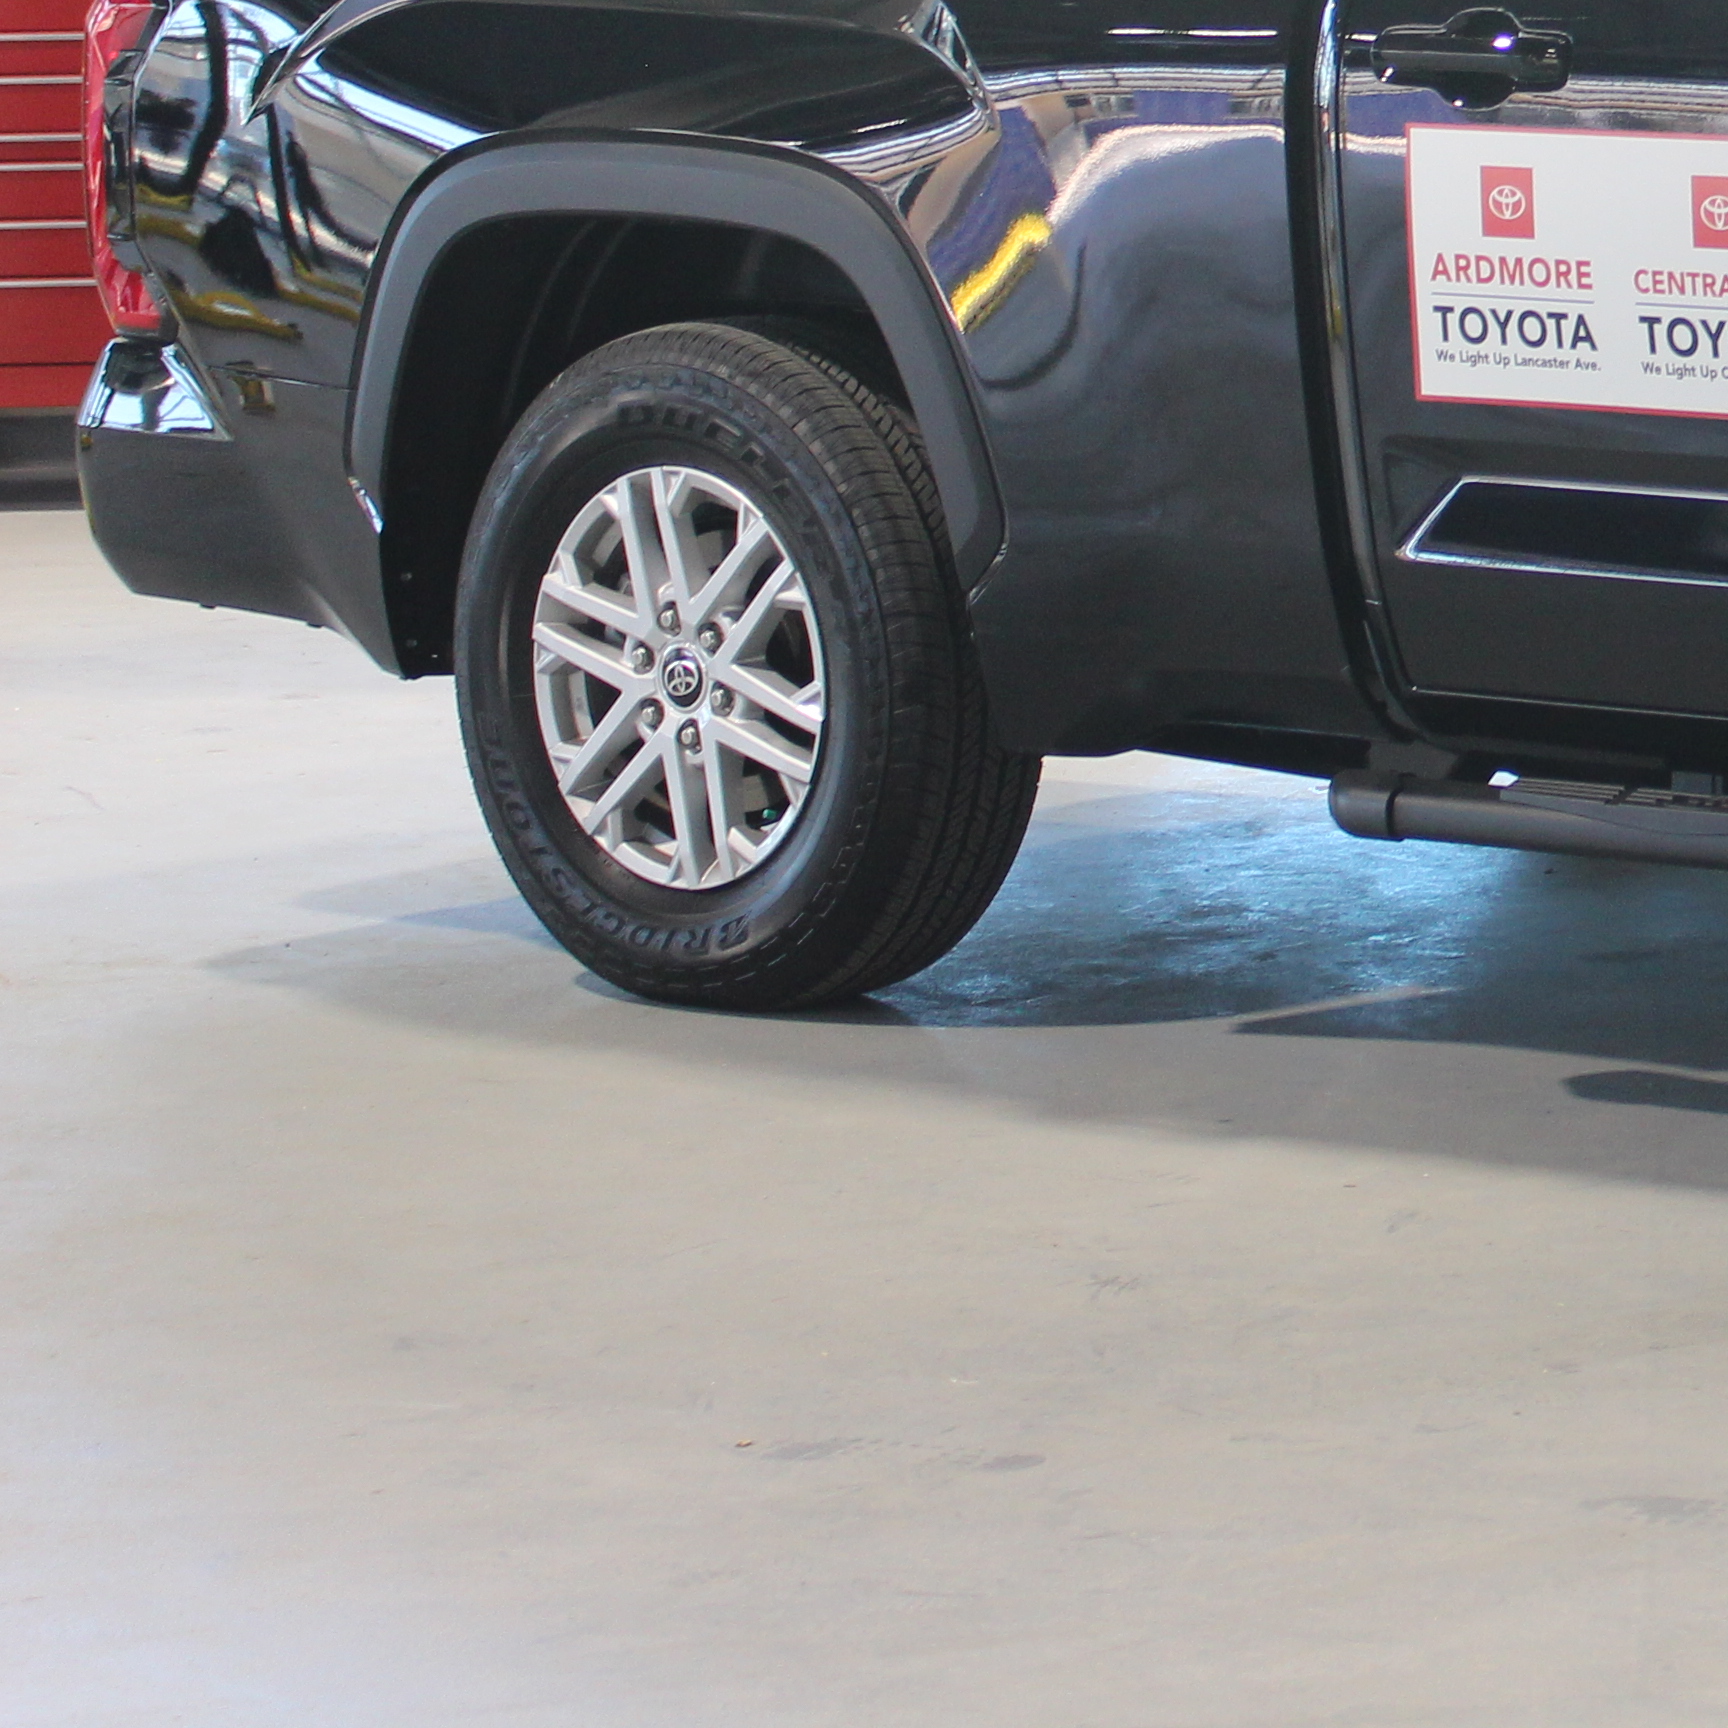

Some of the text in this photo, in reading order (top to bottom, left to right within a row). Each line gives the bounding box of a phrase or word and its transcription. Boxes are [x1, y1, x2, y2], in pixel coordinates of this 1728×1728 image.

[1430, 253, 1594, 291] ARDMORE
[1432, 305, 1599, 352] TOYOTA
[1435, 349, 1602, 372] We Light Up Lancaster Ave.
[1641, 361, 1662, 375] We
[1665, 362, 1697, 380] Light
[1700, 365, 1718, 382] Up
